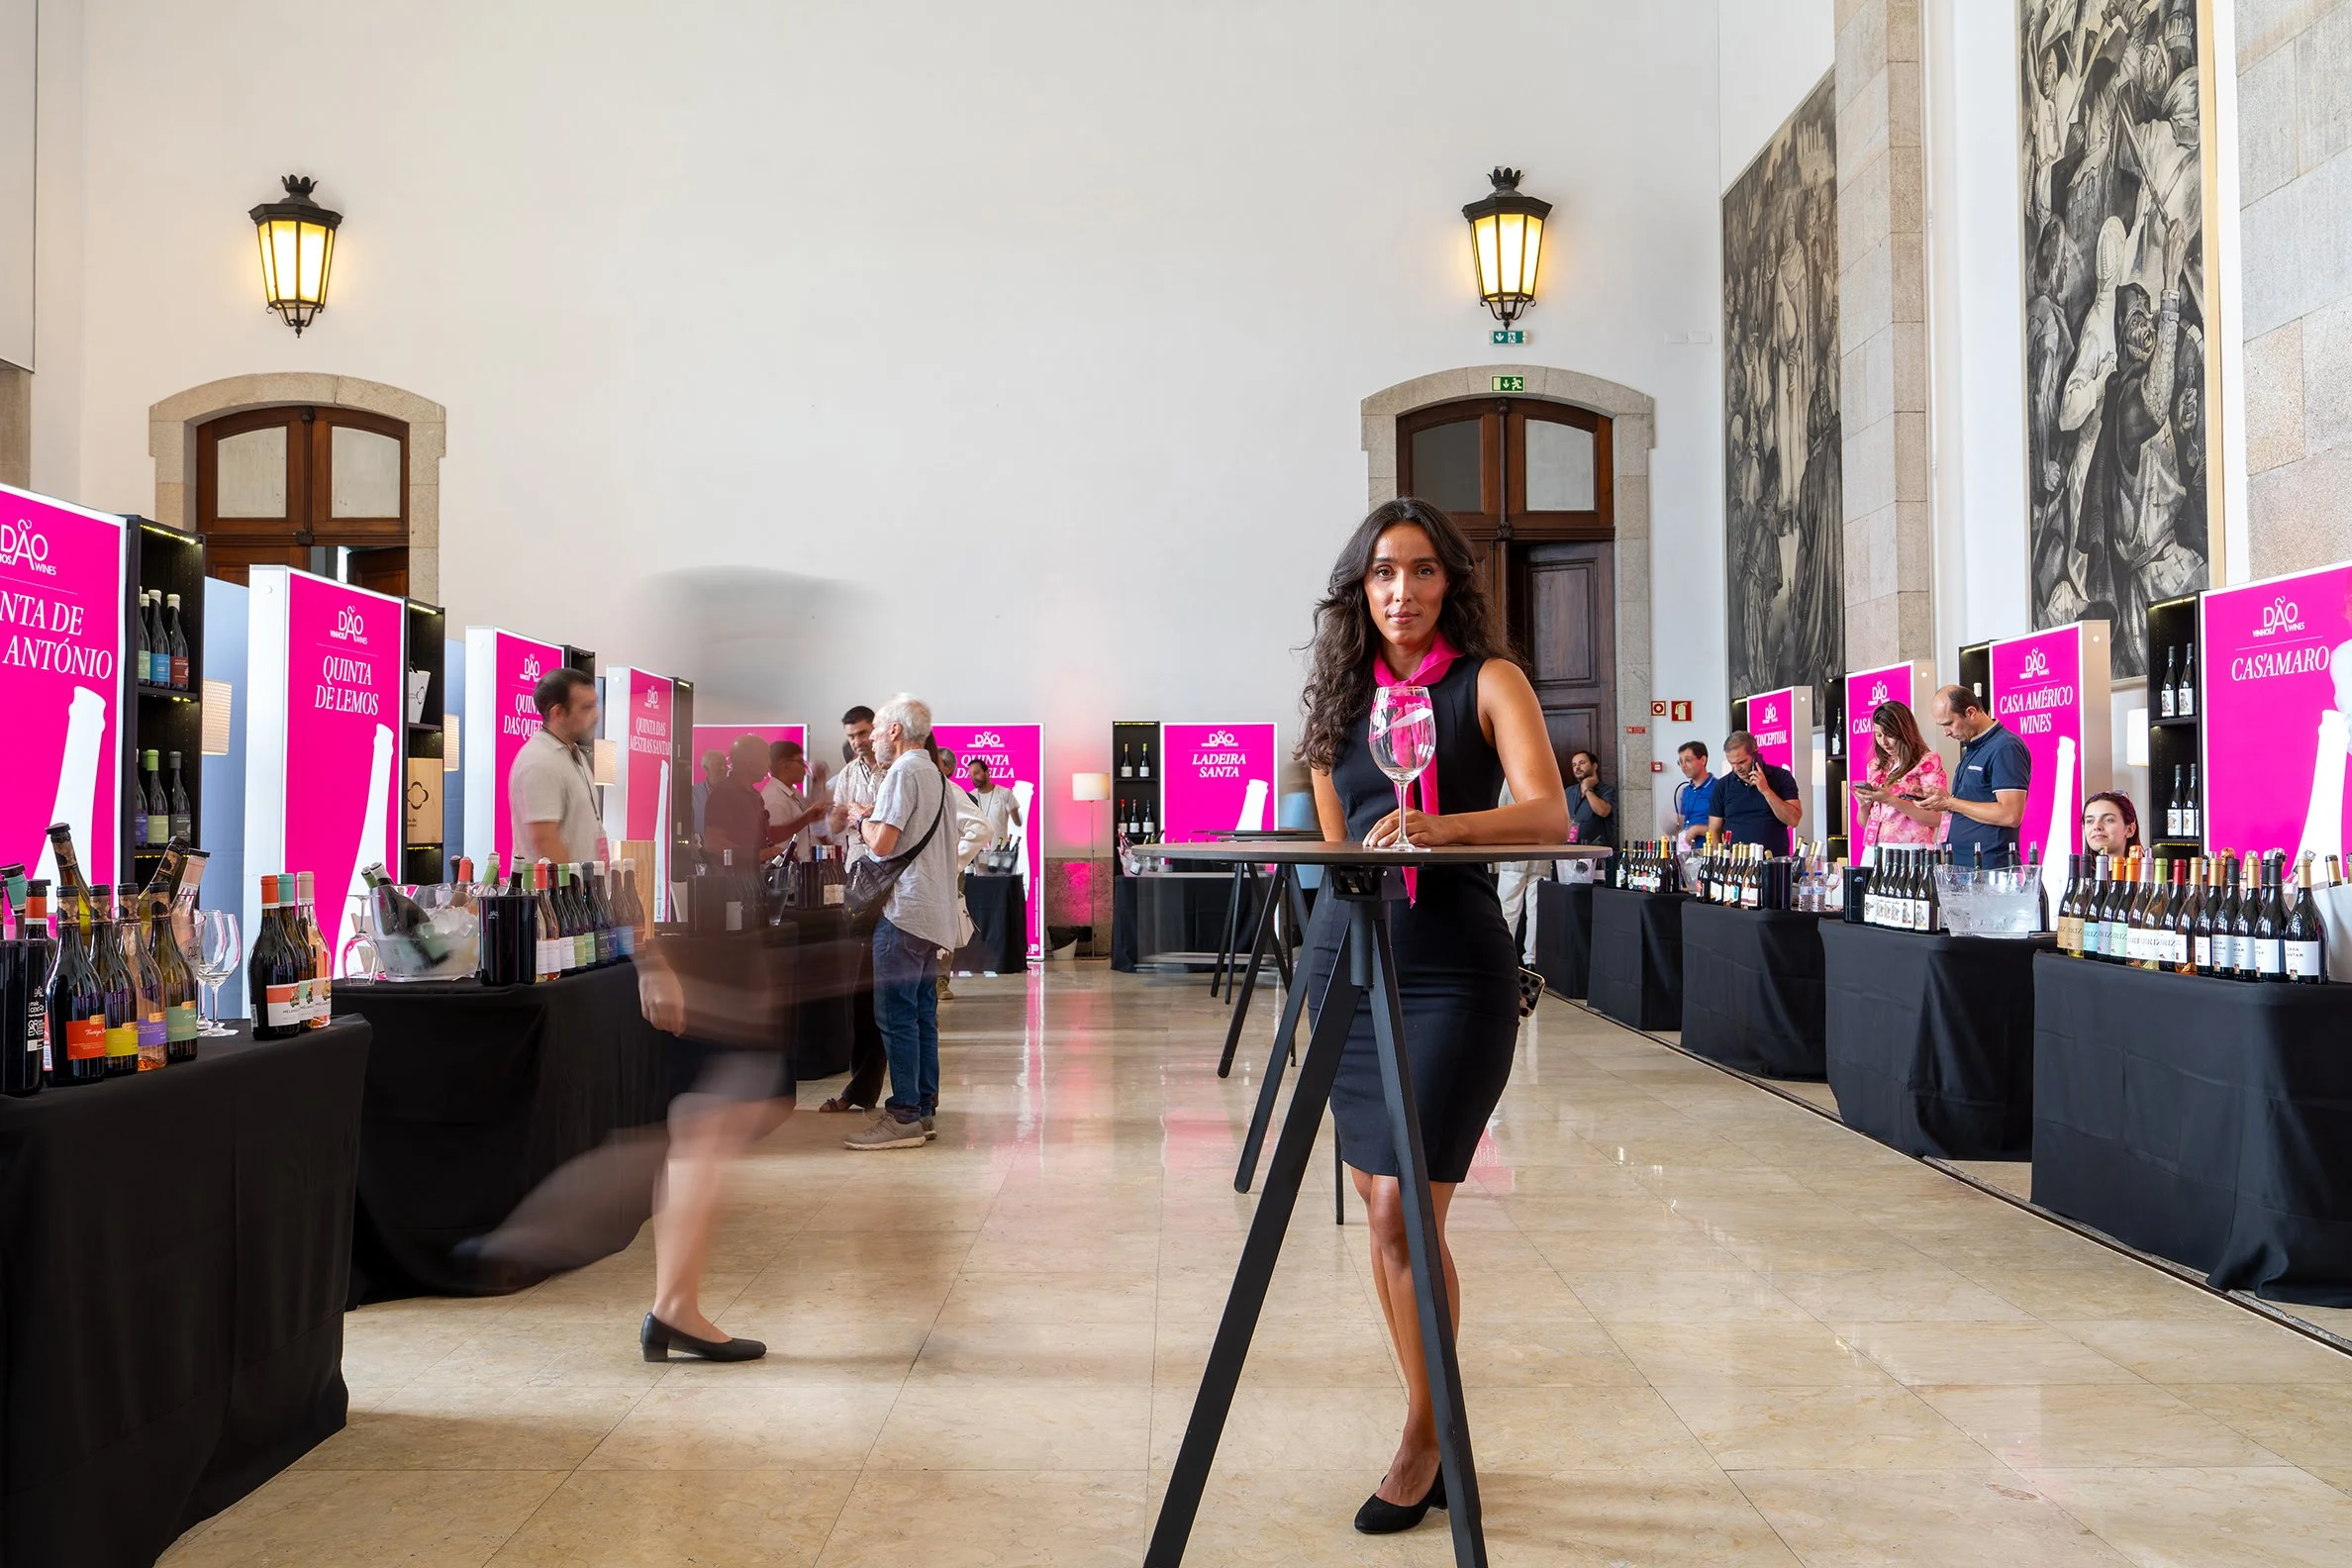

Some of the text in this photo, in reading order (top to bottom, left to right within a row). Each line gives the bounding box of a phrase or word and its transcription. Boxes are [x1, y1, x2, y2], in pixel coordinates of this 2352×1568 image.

[0, 519, 49, 570] DÃO
[34, 562, 56, 576] WINES
[49, 601, 84, 636] DE
[339, 605, 364, 642] DÃO
[2263, 595, 2299, 635] DÃO
[2, 635, 113, 680] ANTÓNIO
[524, 653, 540, 681] DÃO
[2025, 646, 2046, 676] DÃO
[323, 655, 372, 686] QUINTA
[315, 684, 379, 716] DE LEMOS
[1872, 680, 1888, 704] DÃO
[2000, 685, 2074, 715] CASA AMÉRICO
[515, 693, 542, 717] QUIN
[503, 715, 521, 735] DAS
[636, 716, 666, 737] QUINTA DAS
[1852, 717, 1872, 735] CASA
[2019, 713, 2052, 735] WINES
[974, 731, 1001, 747] DÃO
[1209, 731, 1234, 746] DÃO
[1192, 753, 1246, 765] LADEIRA
[1199, 766, 1240, 778] SANTA
